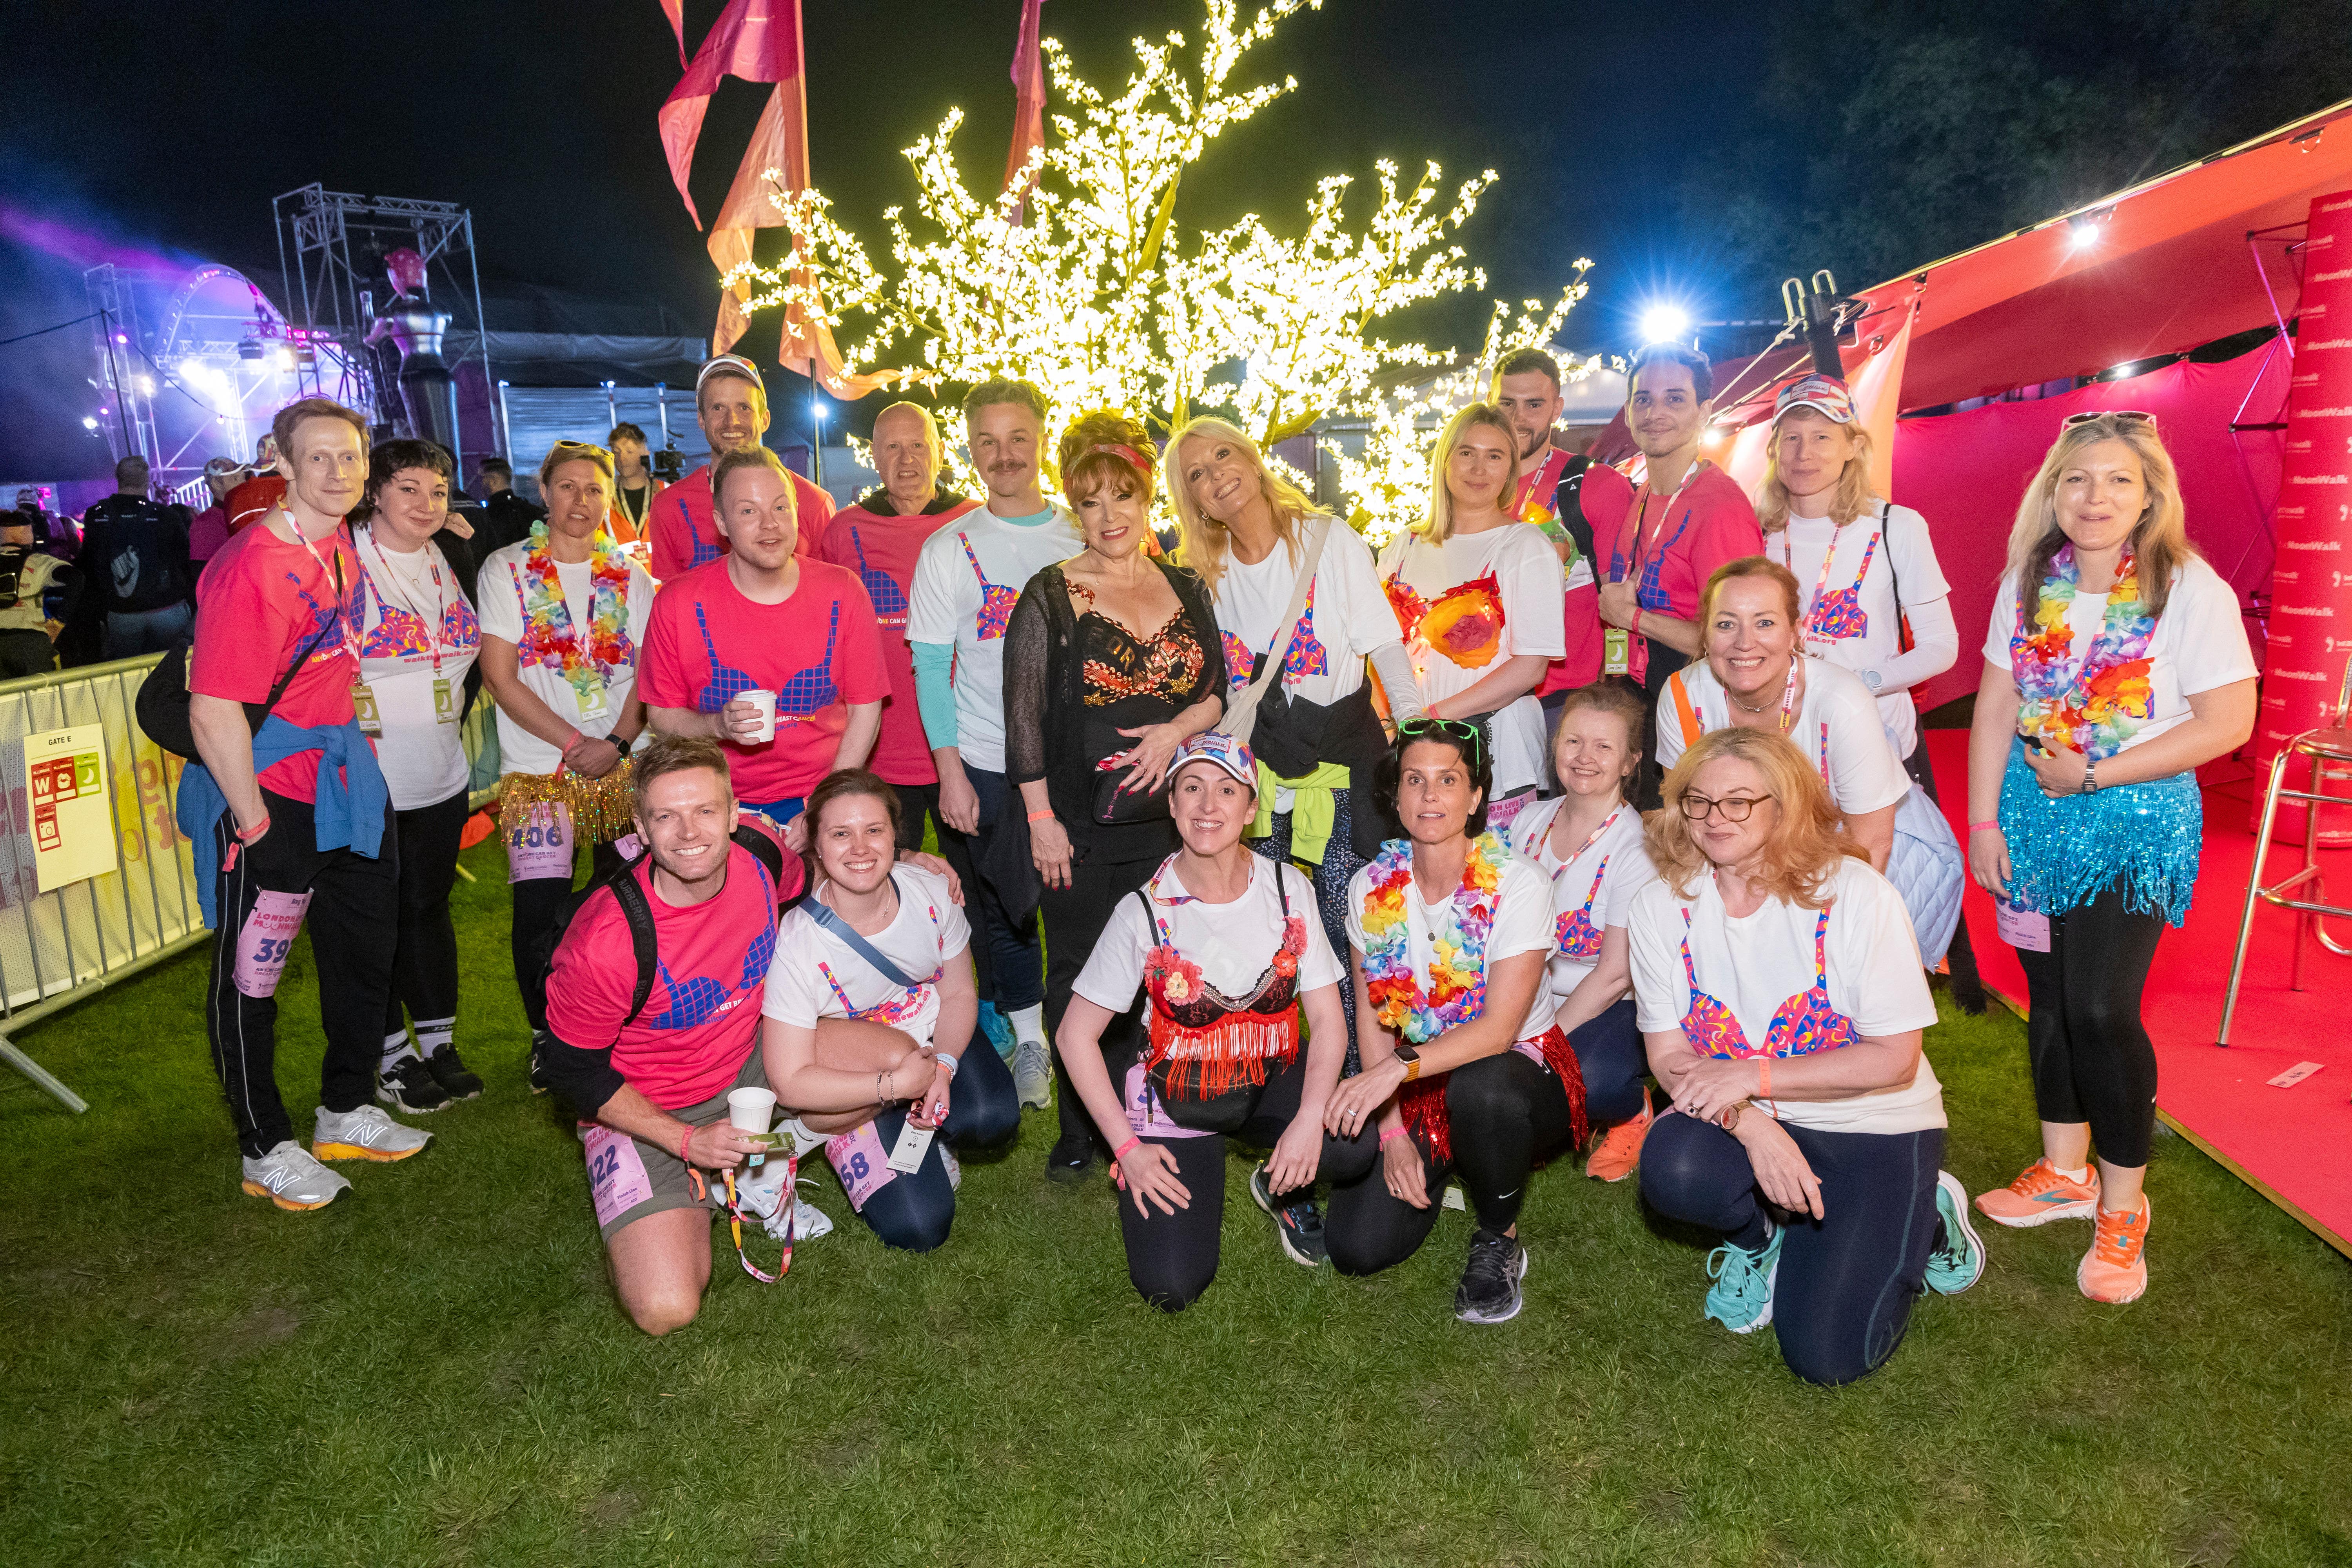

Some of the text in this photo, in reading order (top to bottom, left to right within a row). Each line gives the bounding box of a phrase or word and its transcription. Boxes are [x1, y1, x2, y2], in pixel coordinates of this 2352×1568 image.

[332, 648, 343, 657] CAN
[49, 737, 65, 746] GATE
[34, 777, 50, 795] W
[1505, 800, 1519, 811] LIVE
[512, 827, 563, 849] 406
[1156, 866, 1164, 881] AGAINST
[718, 1002, 731, 1011] GET
[862, 1181, 870, 1190] GET
[617, 1191, 629, 1200] Finish
[858, 1185, 872, 1201] CANCER
